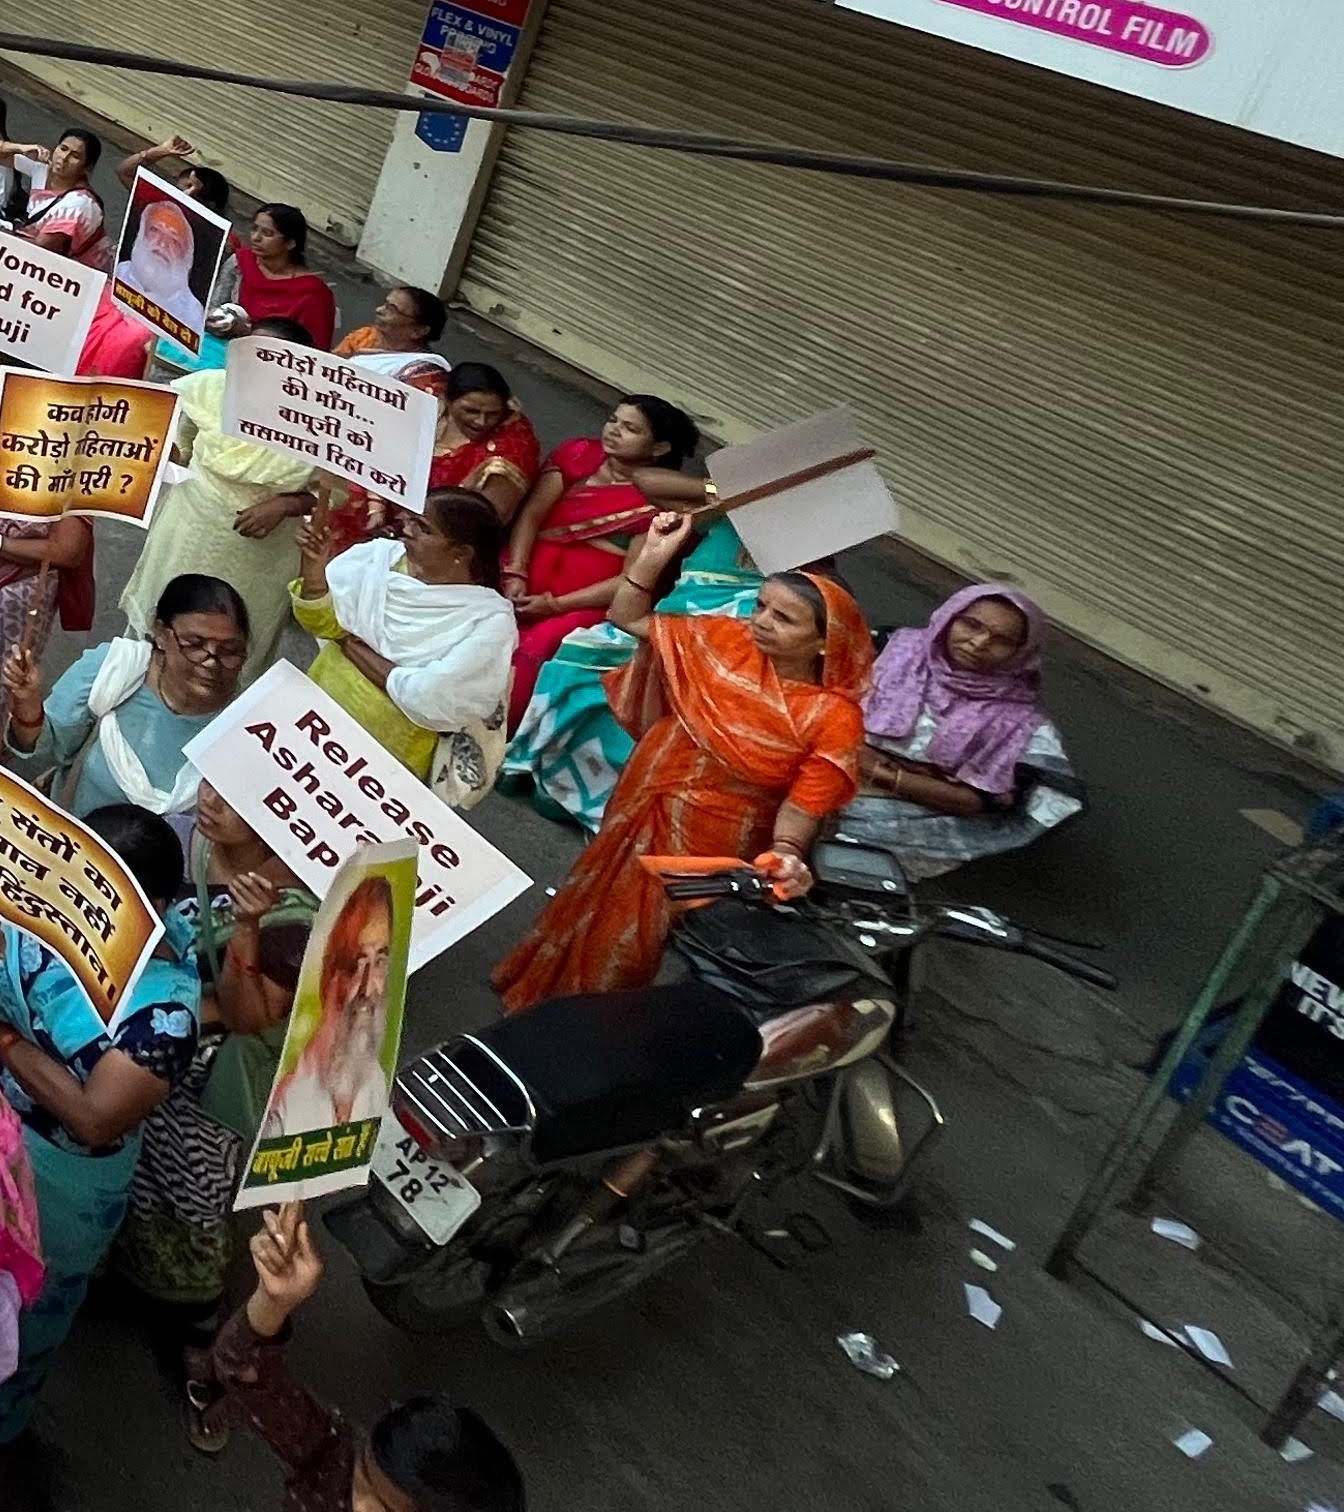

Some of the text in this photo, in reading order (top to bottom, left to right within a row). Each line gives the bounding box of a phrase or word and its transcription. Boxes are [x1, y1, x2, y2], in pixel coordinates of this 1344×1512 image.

[431, 7, 462, 28] FLEX
[477, 24, 513, 46] VINYL
[1119, 10, 1201, 58] FILM
[19, 287, 62, 321] for
[292, 708, 463, 873] Release
[11, 806, 82, 865] संतों
[83, 861, 124, 912] का
[59, 876, 116, 944] नहीं
